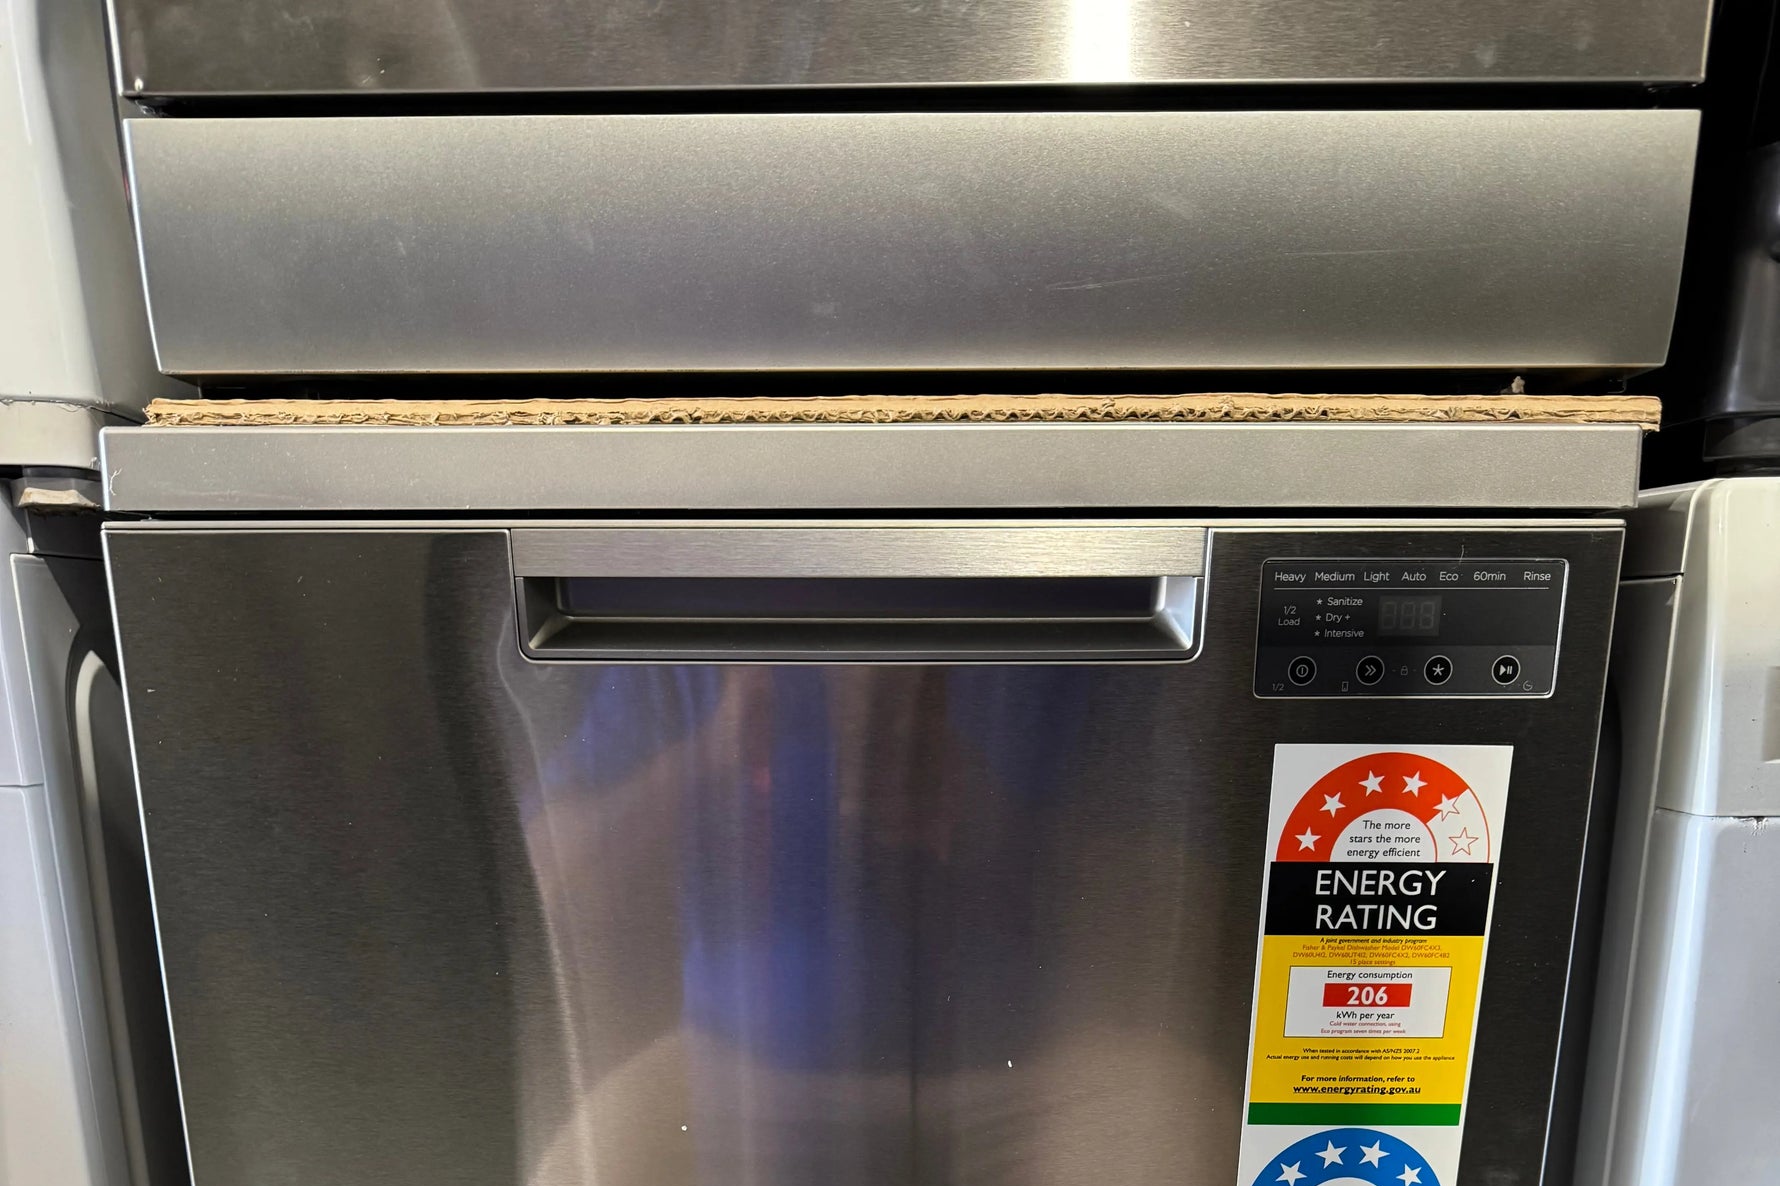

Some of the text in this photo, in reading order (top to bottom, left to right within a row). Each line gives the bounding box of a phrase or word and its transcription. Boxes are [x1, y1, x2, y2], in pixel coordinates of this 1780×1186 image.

[1275, 571, 1551, 582] Heavy Medium Light Auto Eco 60min Rinse
[1327, 597, 1363, 606] Sanitize
[1283, 605, 1297, 615] 1/2
[1278, 617, 1300, 626] Load
[1326, 613, 1343, 623] Dry
[1324, 628, 1364, 638] Intensive
[1363, 820, 1381, 829] The
[1349, 835, 1372, 843] stars
[1376, 834, 1391, 843] the
[1347, 848, 1420, 860] energy efficient
[1315, 870, 1446, 895] ENERGY
[1315, 904, 1437, 930] RATING
[1327, 970, 1413, 980] Energy consumption
[1347, 986, 1388, 1005] 206
[1336, 1011, 1395, 1021] kWh per year
[1338, 1075, 1385, 1083] information,
[1293, 1085, 1421, 1095] www.energyrating.gov.au
